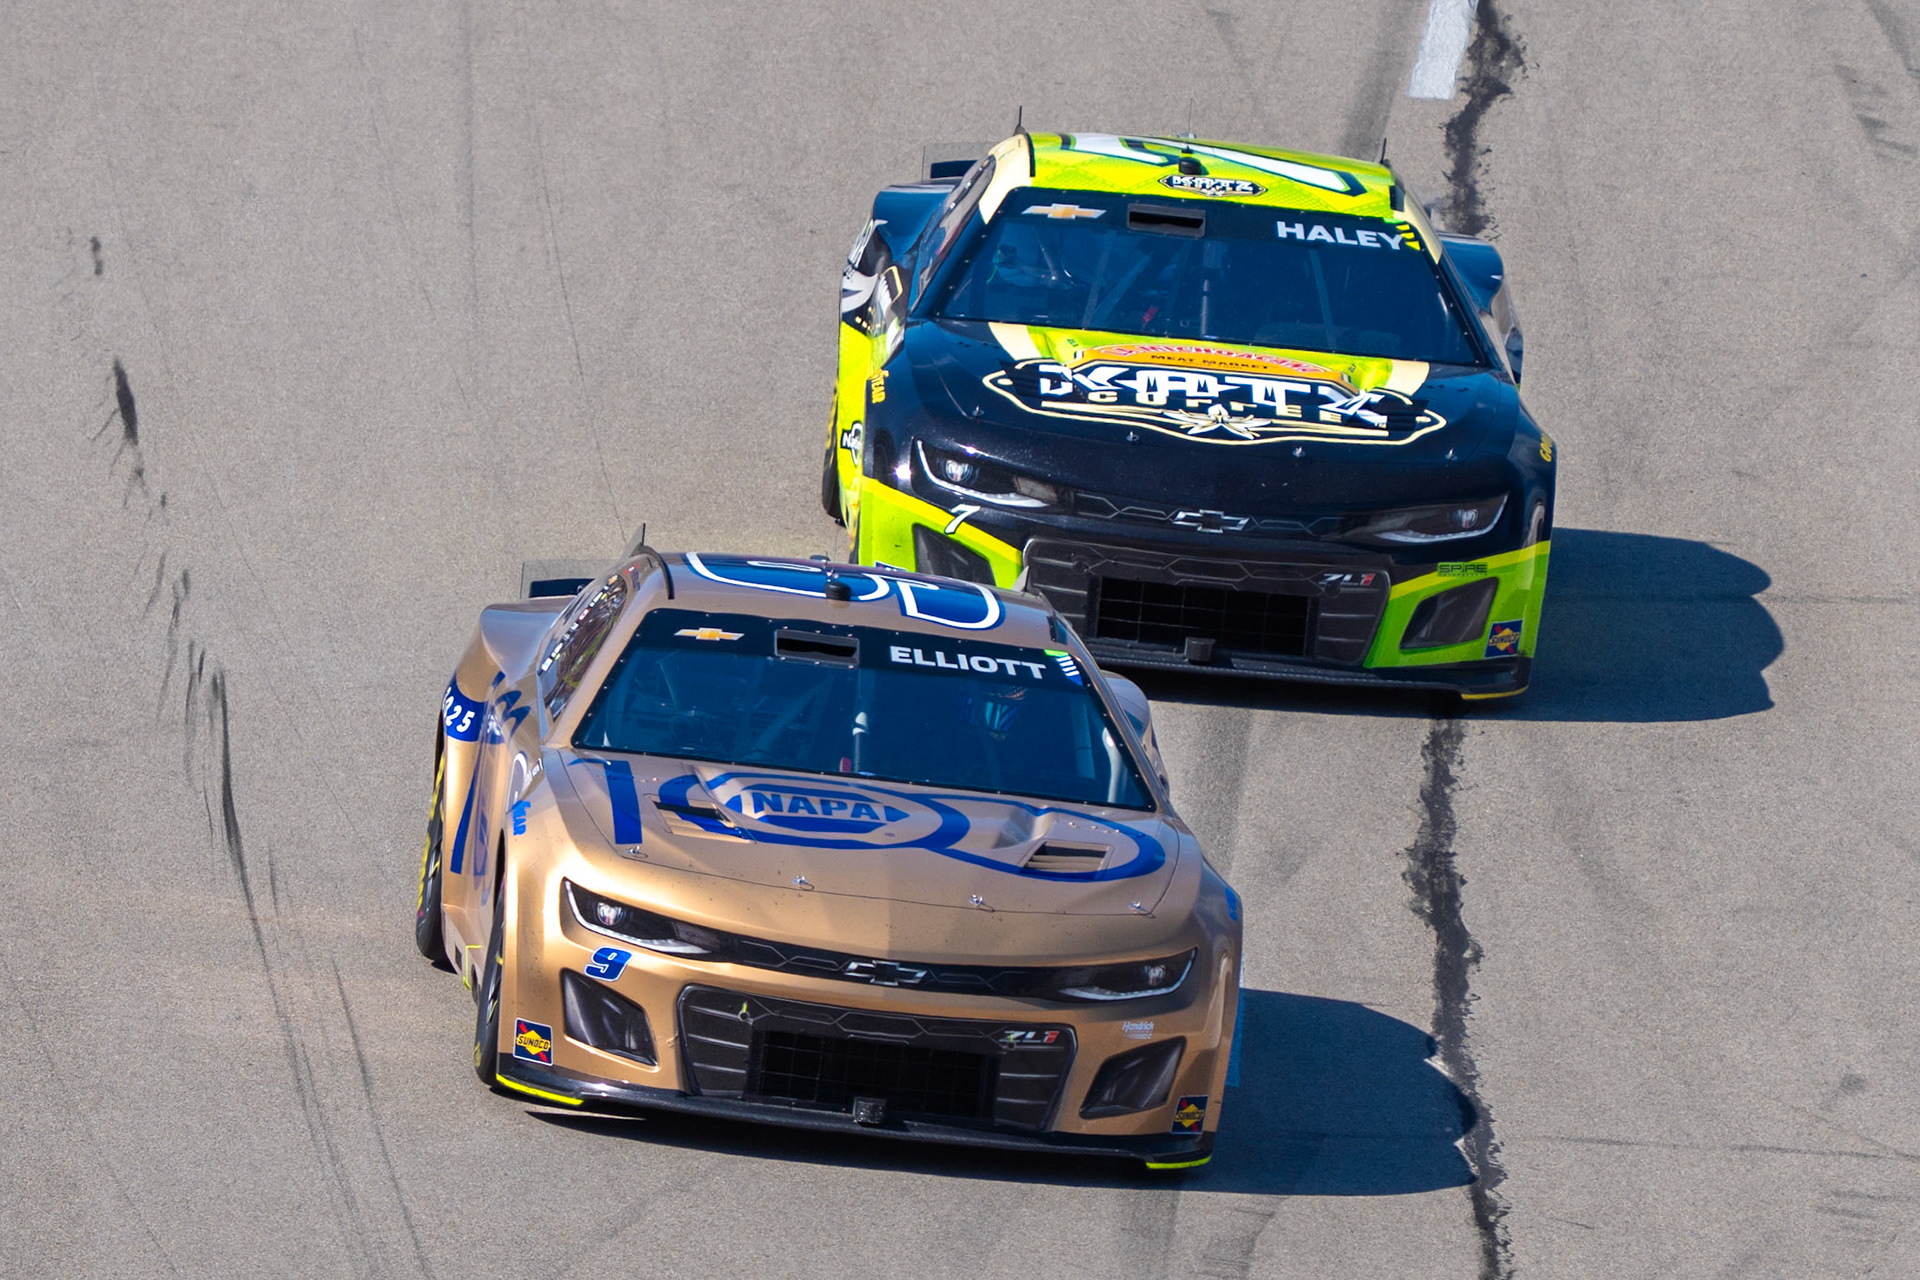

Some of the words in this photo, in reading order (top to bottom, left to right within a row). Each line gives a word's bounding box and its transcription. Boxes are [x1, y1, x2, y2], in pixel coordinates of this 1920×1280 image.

[1277, 221, 1402, 250] HALEY
[1203, 359, 1269, 369] MARKET
[1088, 391, 1342, 423] COFFEE
[944, 503, 981, 534] 7
[1438, 564, 1487, 574] SPIRE
[1318, 573, 1376, 586] ZL1
[1490, 631, 1520, 646] SUNOCO
[890, 646, 1046, 679] ELLIOTT
[752, 792, 880, 820] NAPA
[584, 946, 633, 982] 9
[1122, 1020, 1155, 1033] Hendrick
[517, 1035, 550, 1050] SUNOCO
[999, 1030, 1060, 1044] ZL1
